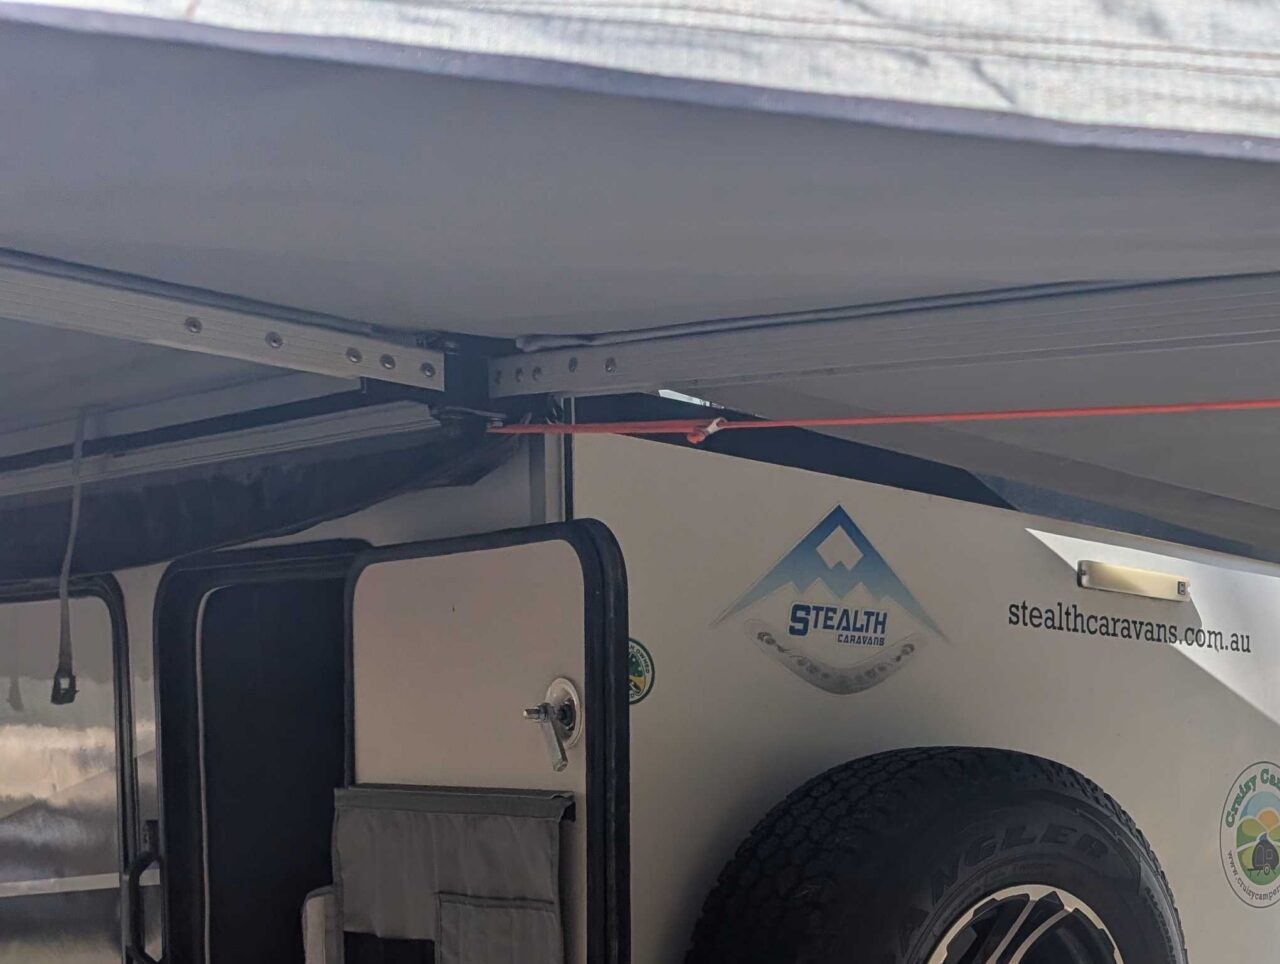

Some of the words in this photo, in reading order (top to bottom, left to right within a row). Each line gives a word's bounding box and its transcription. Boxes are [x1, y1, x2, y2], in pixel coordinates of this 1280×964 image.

[788, 603, 888, 636] STEALTH
[1008, 600, 1252, 653] stealthcaravans.com.au
[837, 634, 885, 647] CARAVANS
